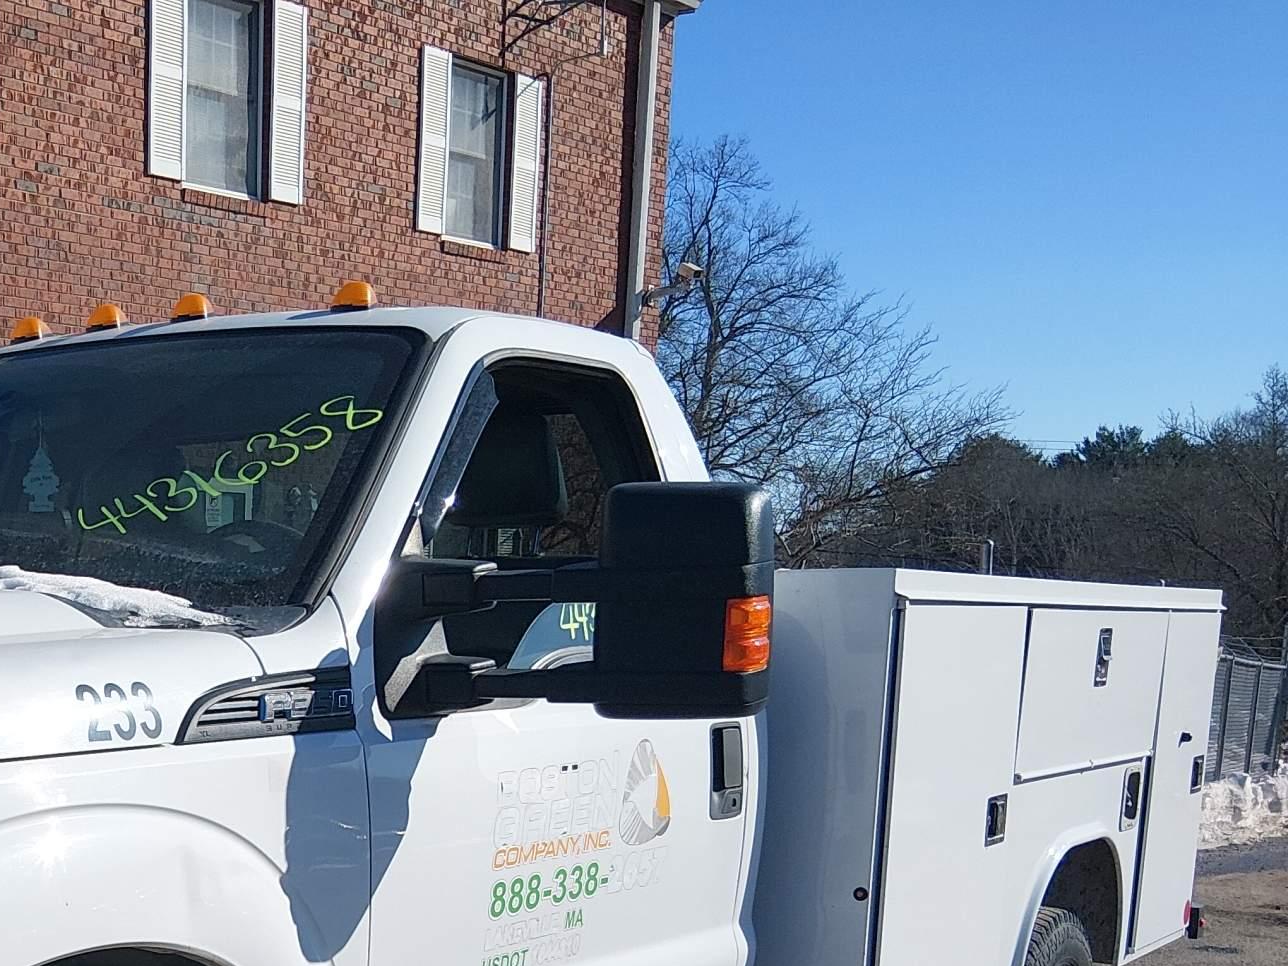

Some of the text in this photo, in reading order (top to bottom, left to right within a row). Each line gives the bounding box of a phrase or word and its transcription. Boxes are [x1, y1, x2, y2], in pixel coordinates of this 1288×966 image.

[78, 396, 383, 534] 44316358
[75, 681, 162, 742] 233
[564, 909, 584, 929] MA
